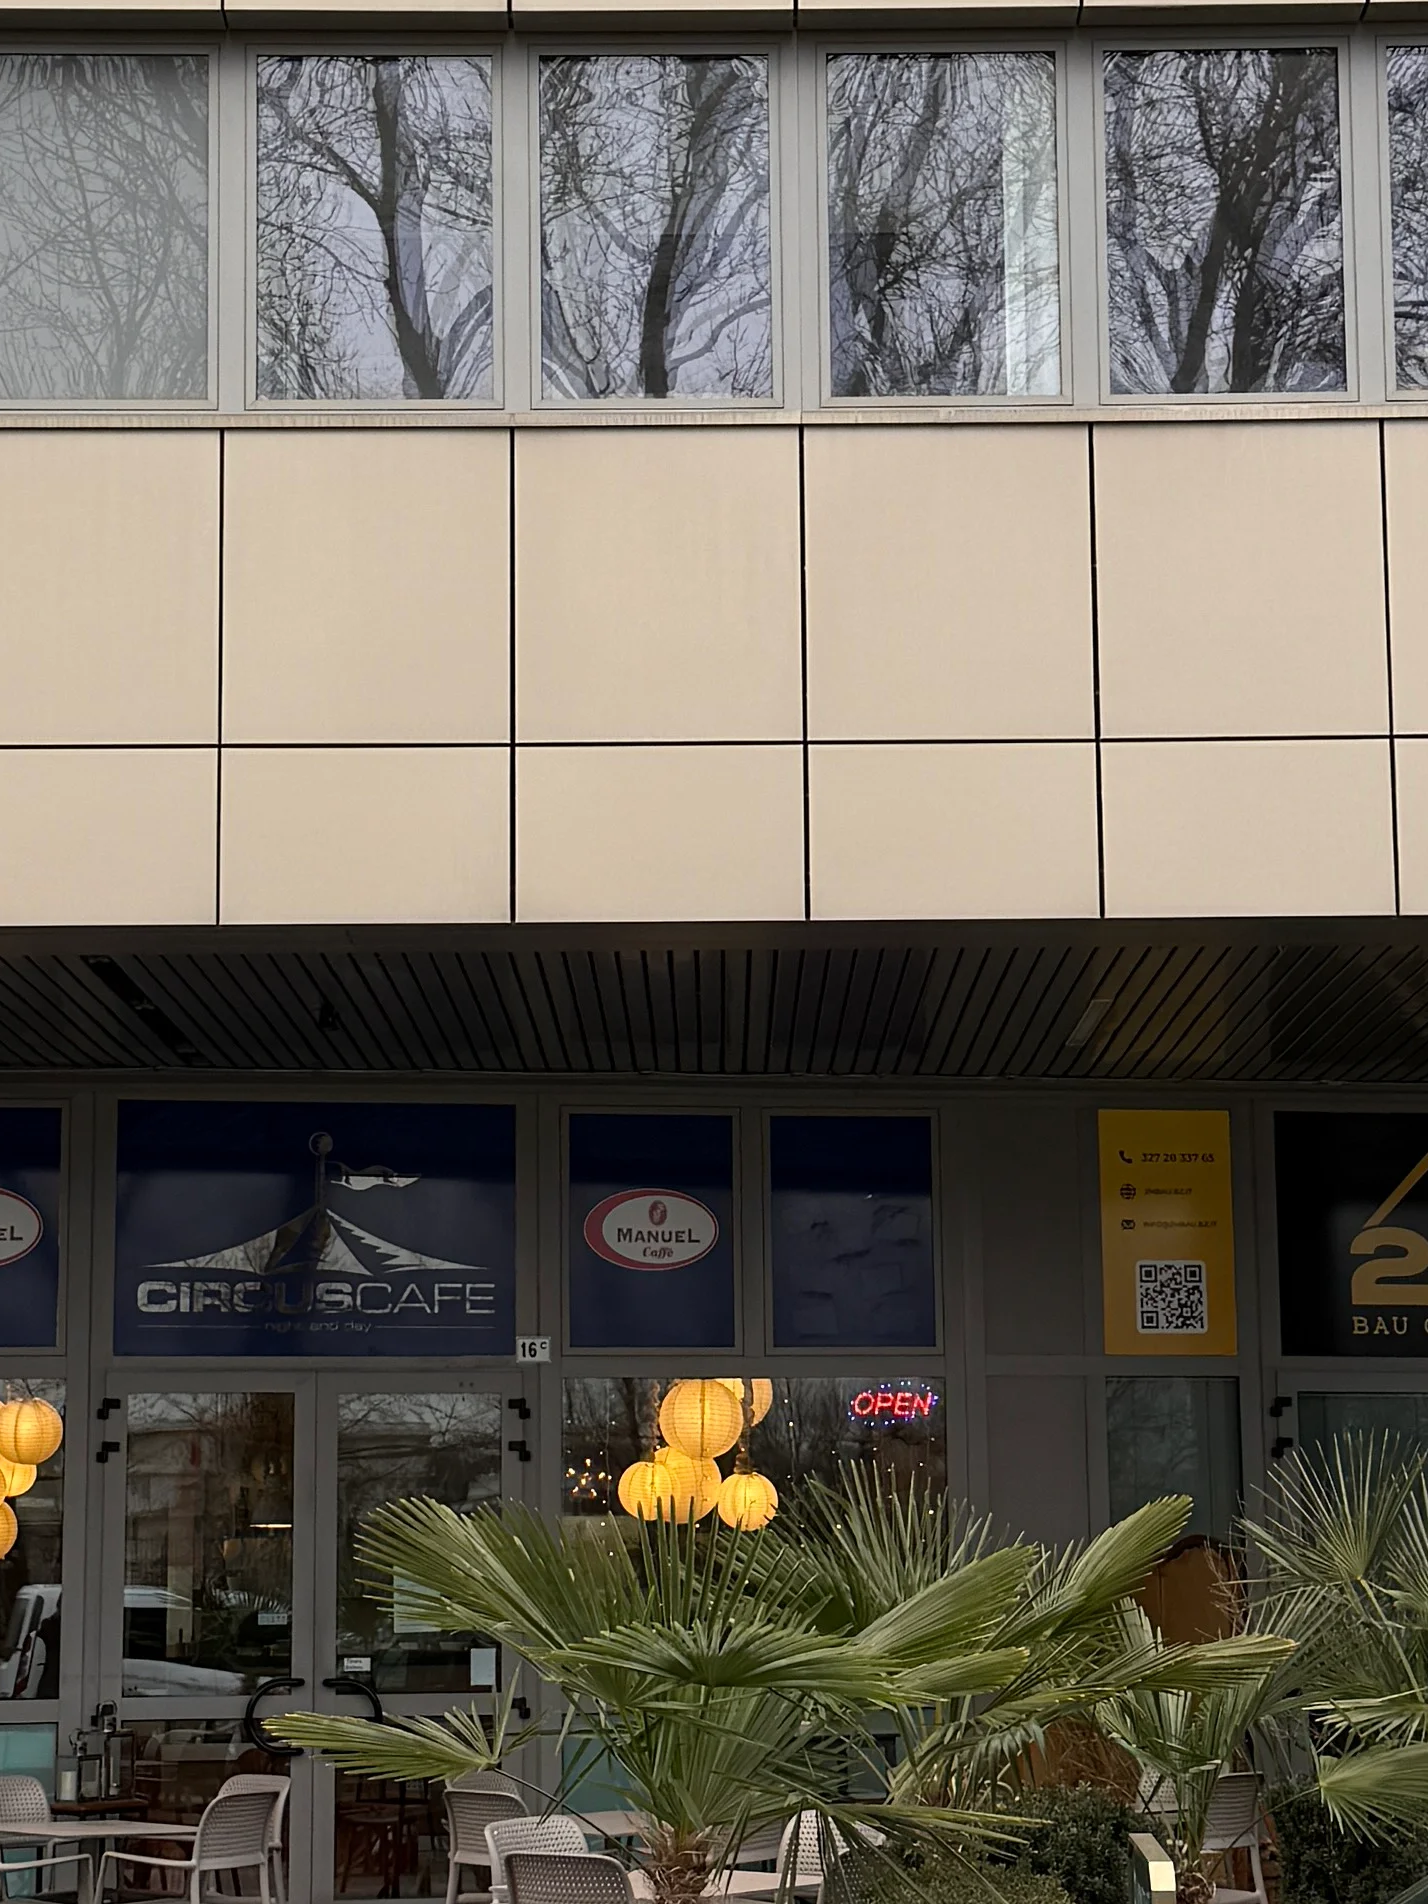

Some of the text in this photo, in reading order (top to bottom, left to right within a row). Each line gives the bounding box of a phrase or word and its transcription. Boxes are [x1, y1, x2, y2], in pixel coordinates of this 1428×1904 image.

[616, 1227, 701, 1244] MANUEL
[1351, 1315, 1410, 1336] BAU
[854, 1391, 933, 1416] OPEN
